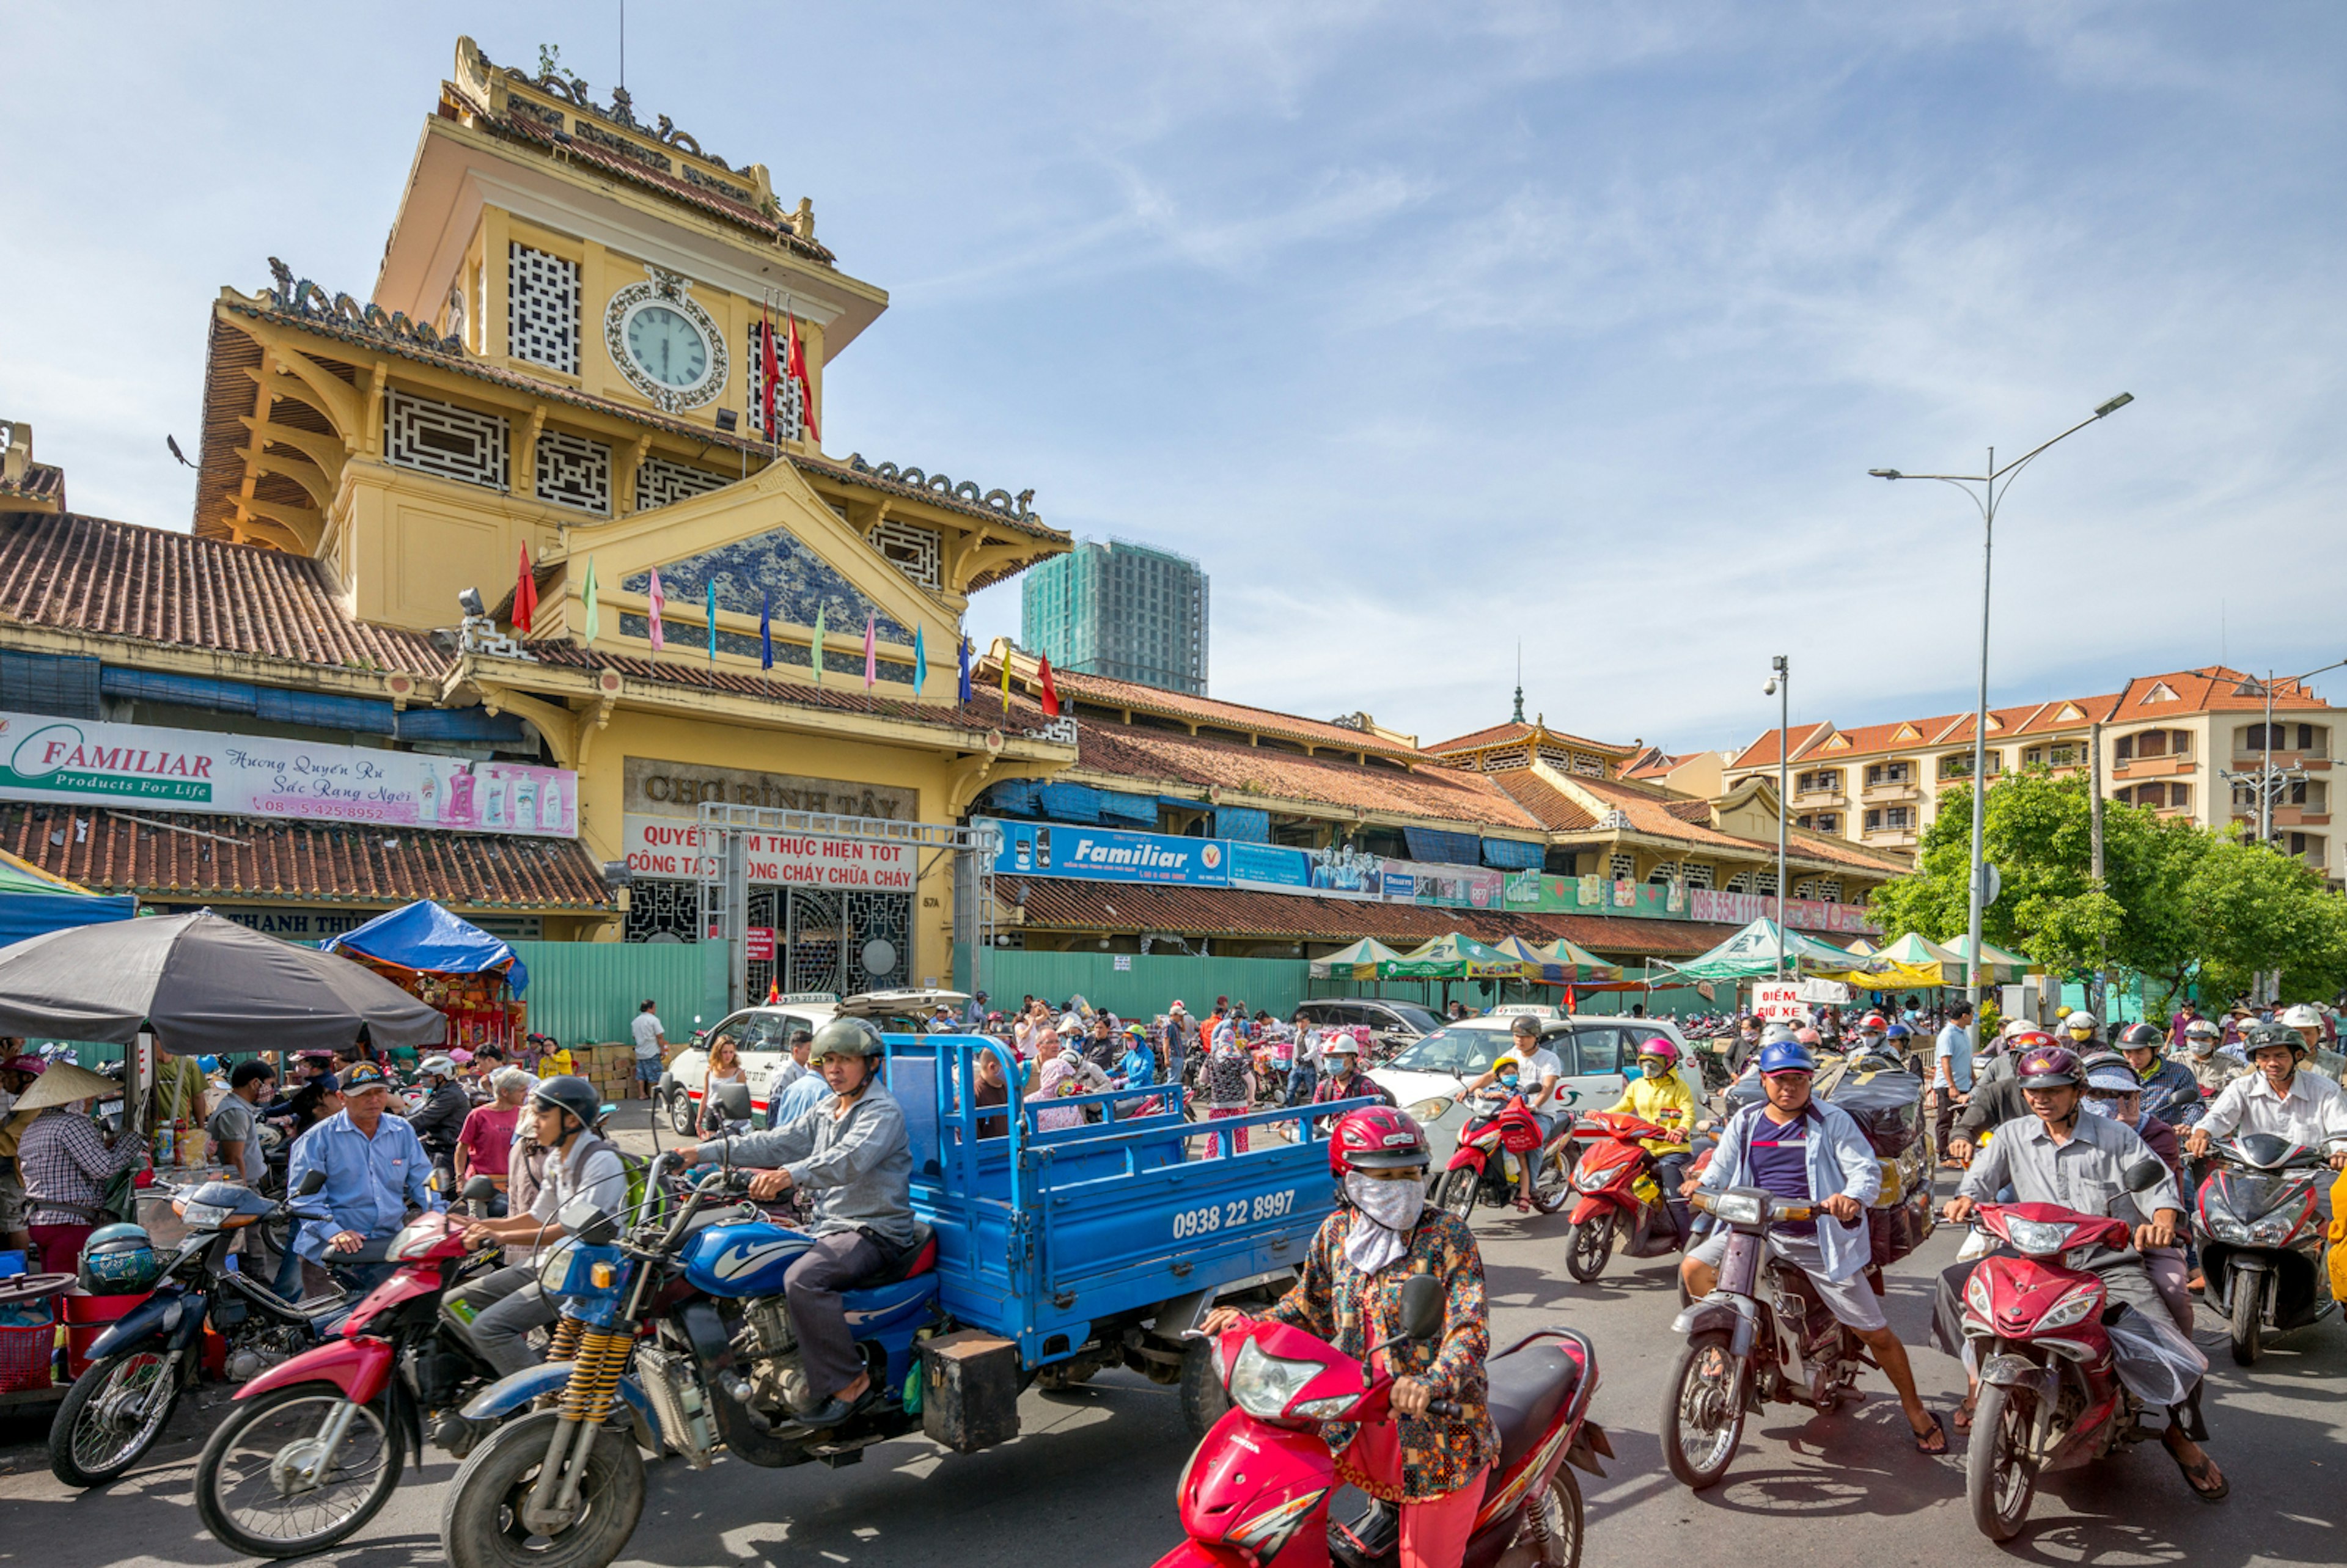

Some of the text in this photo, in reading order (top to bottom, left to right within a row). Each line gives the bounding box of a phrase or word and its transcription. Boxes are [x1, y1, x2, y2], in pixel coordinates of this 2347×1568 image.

[42, 741, 213, 778] FAMILIAR
[55, 773, 207, 799] Products For Life
[645, 775, 726, 815] CHỢ
[264, 799, 284, 813] 08
[300, 804, 310, 814] 5
[314, 804, 343, 816] 425
[347, 807, 384, 819] 8952
[767, 836, 817, 858] THỰC
[823, 838, 863, 862] HIỆN
[1074, 838, 1188, 868] Familiar
[627, 849, 676, 873] CÔNG
[783, 863, 825, 882] CHÁY
[828, 863, 869, 885] CHỮA
[874, 868, 912, 887] CHÁY
[1472, 887, 1488, 901] RP7
[1691, 889, 1713, 919] 096
[1716, 890, 1737, 923] 554
[1762, 987, 1796, 1002] ĐIỂM
[1782, 1007, 1801, 1017] XE
[1172, 1189, 1295, 1239] 0938 22 8997
